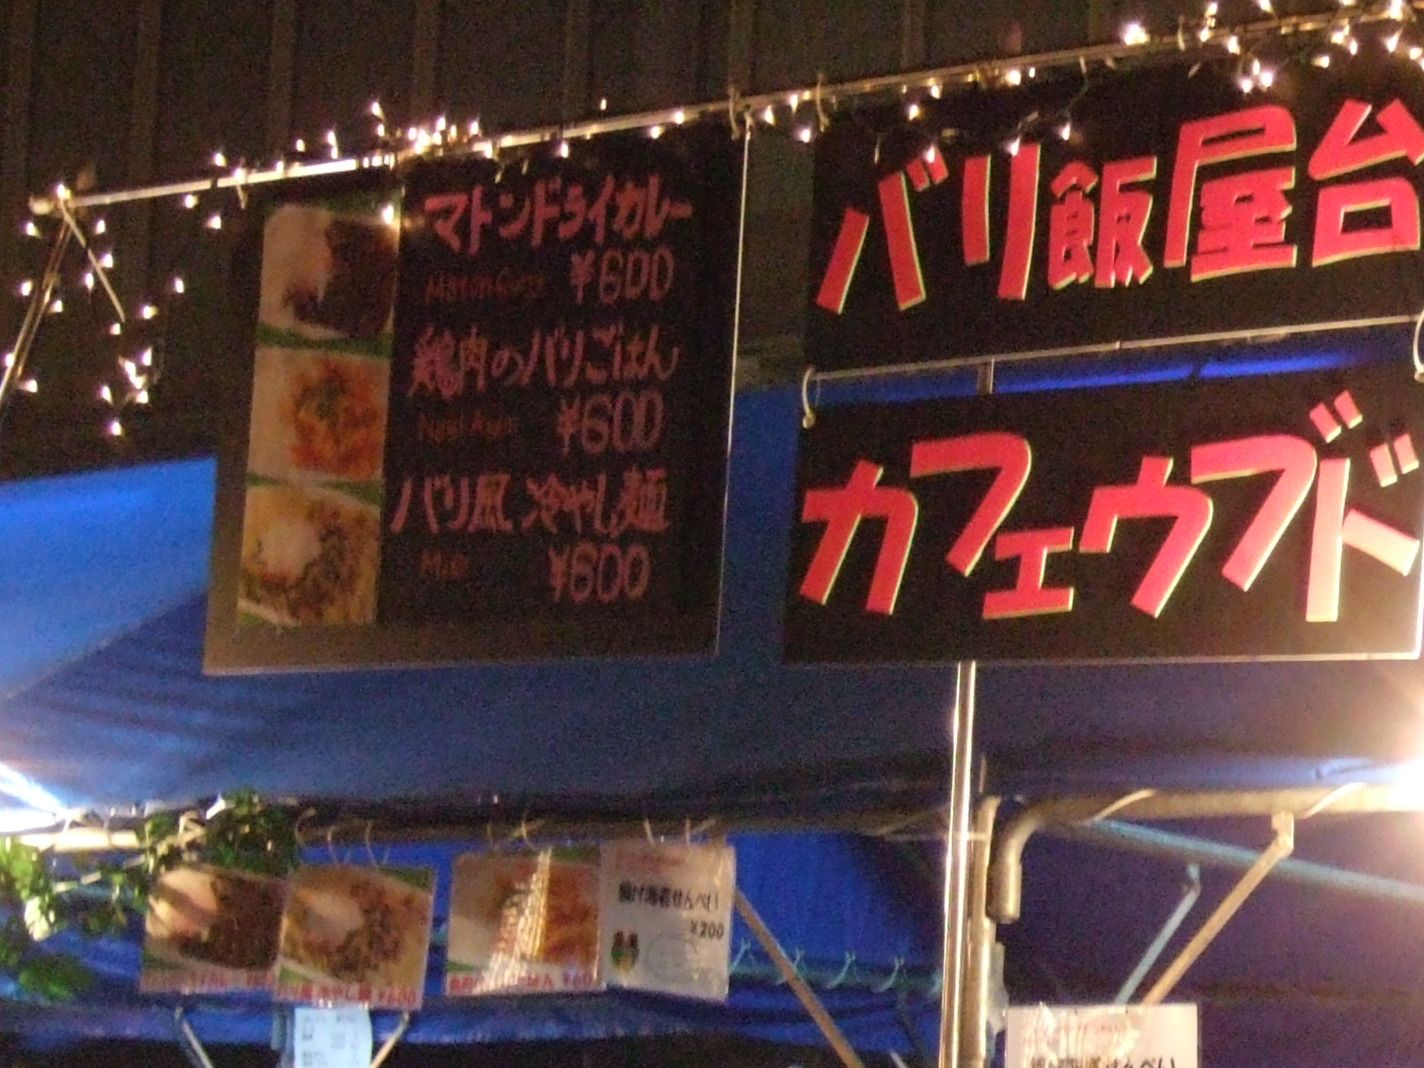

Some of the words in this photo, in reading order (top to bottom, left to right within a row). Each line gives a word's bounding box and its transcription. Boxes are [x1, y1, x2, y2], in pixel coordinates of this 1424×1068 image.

[424, 174, 692, 255] マトンドライカレー
[570, 248, 675, 303] ¥600
[557, 389, 664, 455] ¥600
[800, 390, 1420, 621] カフェウブド
[548, 543, 650, 602] ¥600
